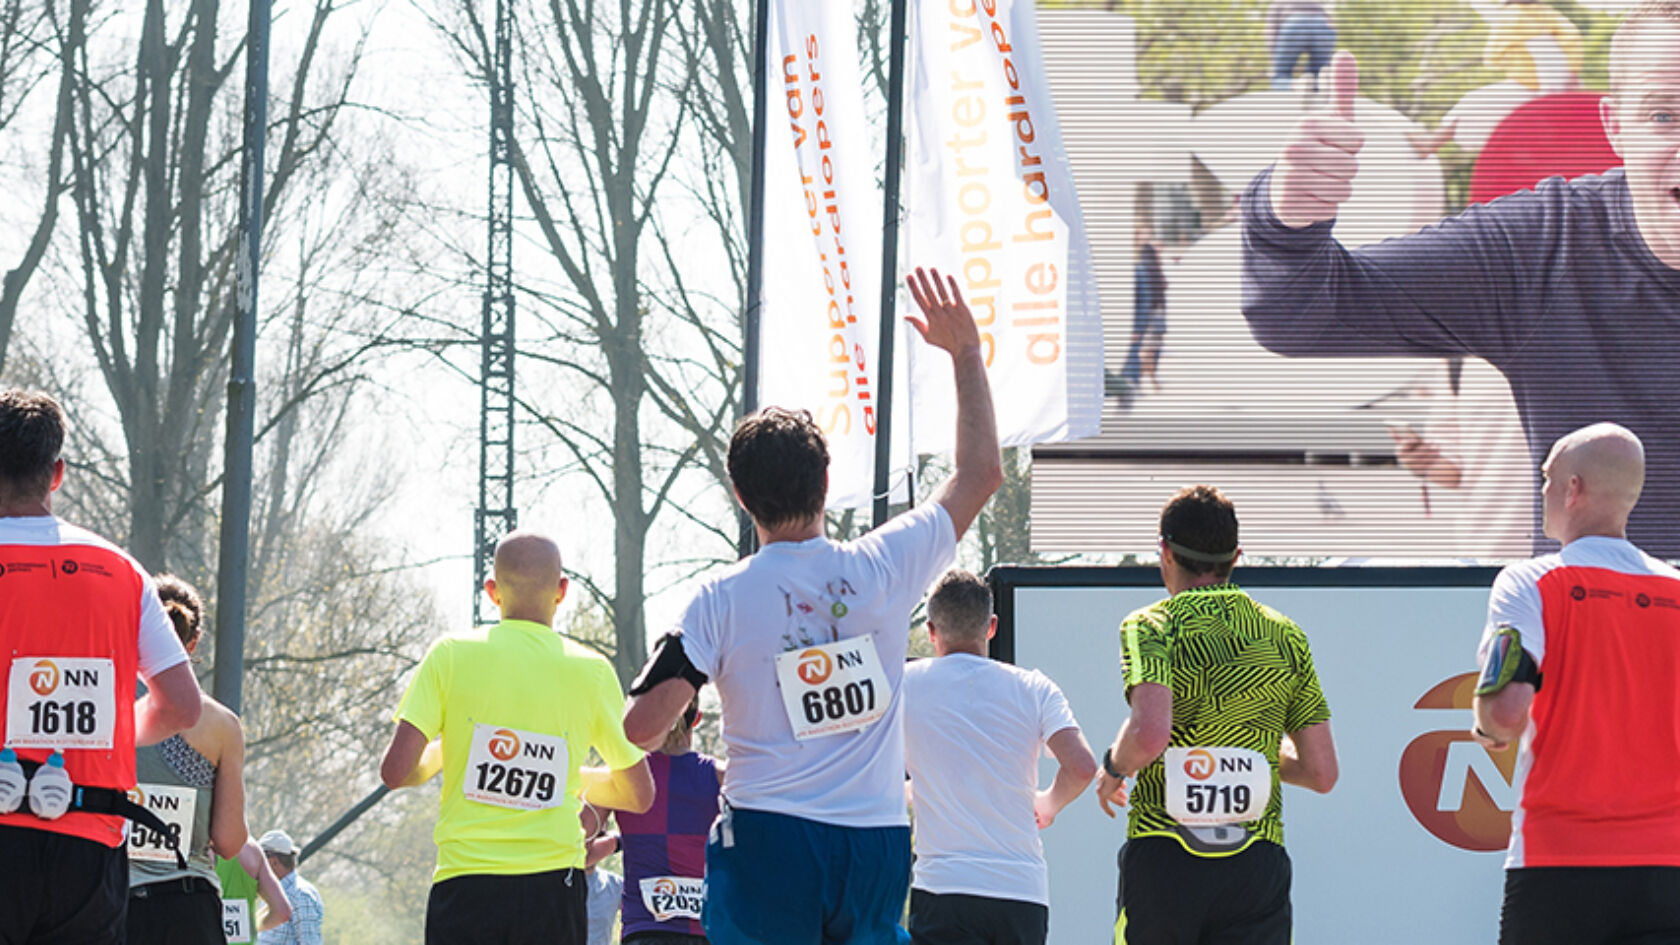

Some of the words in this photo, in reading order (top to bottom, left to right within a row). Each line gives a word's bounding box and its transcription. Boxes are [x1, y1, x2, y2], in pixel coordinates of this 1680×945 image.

[783, 54, 807, 149] van
[806, 33, 857, 324] hardlopers
[799, 166, 851, 436] Suppoter
[1012, 262, 1060, 365] alle
[854, 342, 876, 436] alle
[836, 650, 863, 670] NN
[64, 670, 99, 687] NN
[28, 700, 96, 735] 1618
[802, 678, 875, 723] 6807
[524, 741, 555, 761] NN
[1220, 758, 1252, 772] NN
[476, 762, 556, 802] 12679
[1186, 785, 1250, 814] 5719
[150, 795, 179, 811] NN
[225, 905, 240, 914] NN
